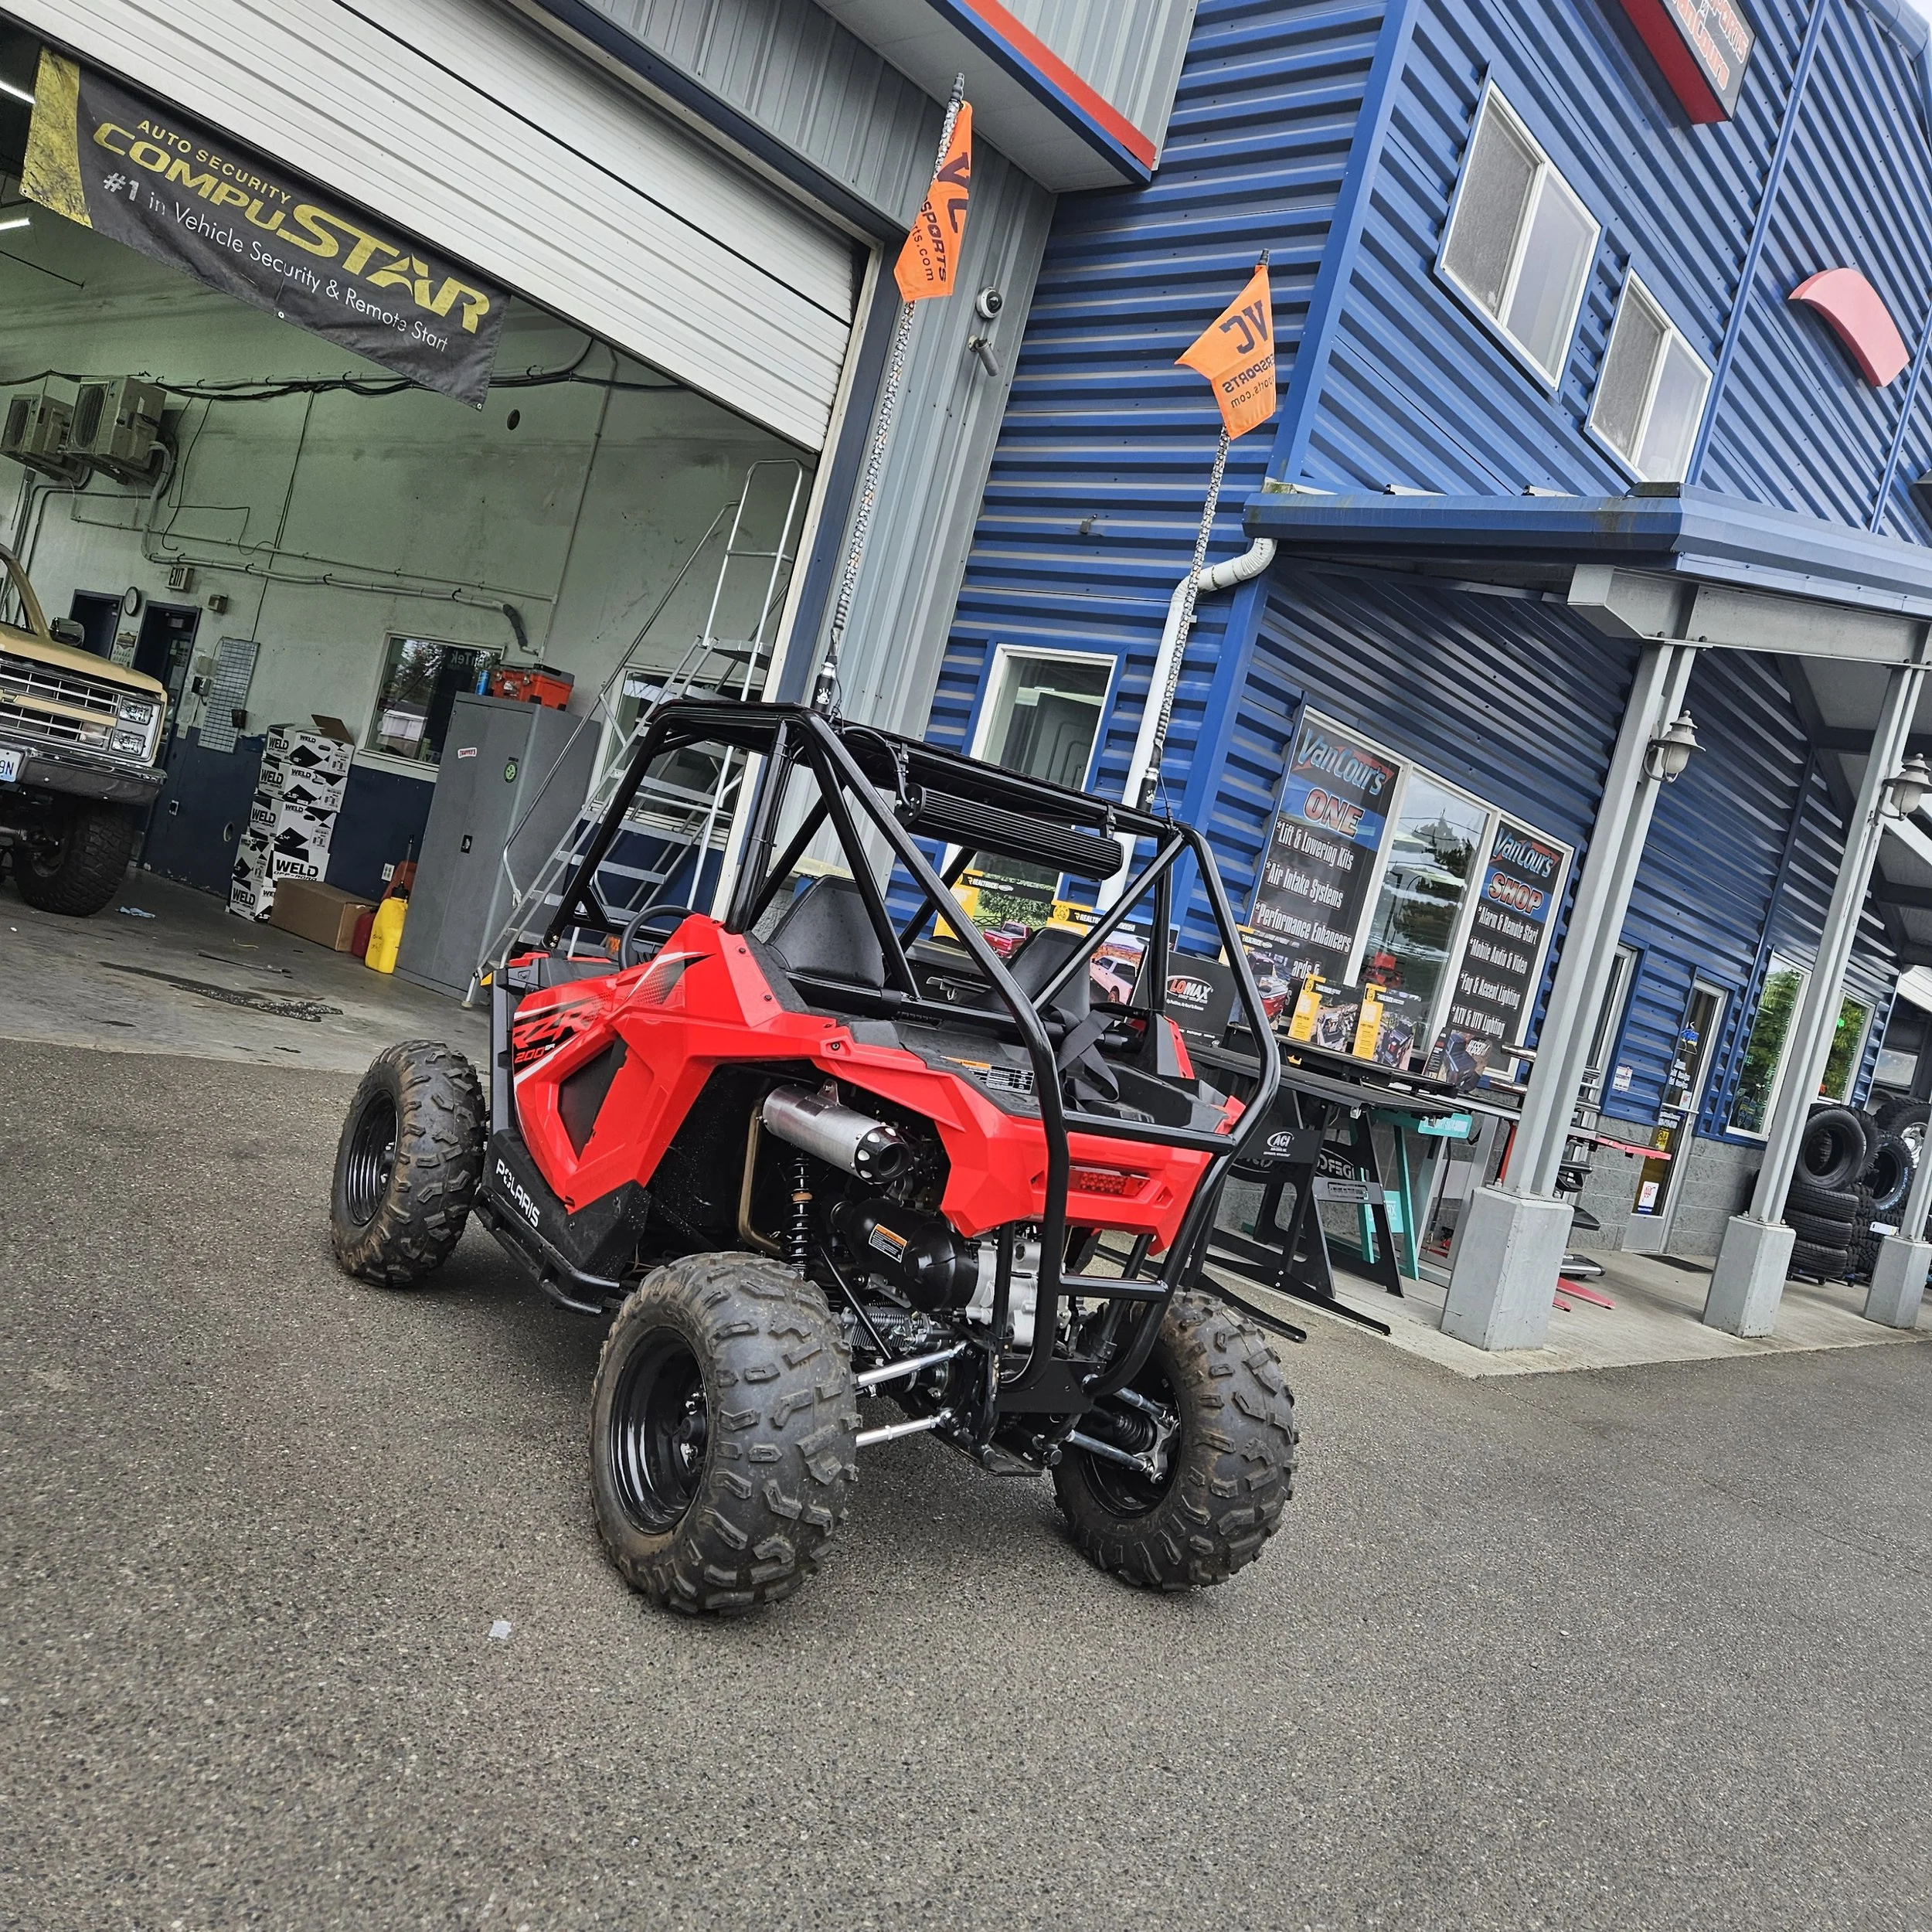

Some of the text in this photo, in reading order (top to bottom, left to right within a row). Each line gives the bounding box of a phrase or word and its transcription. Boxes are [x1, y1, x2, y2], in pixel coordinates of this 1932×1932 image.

[137, 120, 292, 205] AUTO SECURITY
[103, 172, 449, 352] #1 in Vehicle Security & Remote Start
[268, 736, 290, 750] WELD
[300, 734, 316, 743] WELD
[260, 768, 284, 785] WELD
[291, 768, 311, 779] WELD
[1298, 728, 1386, 796] VanCour's
[251, 808, 277, 825] WELD
[284, 804, 304, 813] WELD
[1304, 787, 1366, 840] ONE
[1294, 828, 1302, 851] &
[1301, 832, 1338, 867] Lowering
[1337, 846, 1354, 871] Kits
[1492, 828, 1555, 878] VanCour's
[276, 859, 319, 878] WELD
[232, 888, 256, 906] WELD
[1283, 868, 1310, 896] Intake
[1309, 879, 1344, 909] Systems
[1488, 872, 1544, 915] SHOP
[1311, 923, 1352, 953] Enhancers
[1497, 913, 1503, 930] &
[1502, 916, 1524, 940] Remote
[1522, 923, 1539, 945] Start
[1490, 946, 1507, 968] Audio
[1506, 952, 1513, 968] &
[1512, 954, 1528, 975] Video
[1169, 978, 1211, 1002] LOMAX
[1473, 977, 1480, 994] &
[1478, 978, 1500, 1002] Accent
[1498, 985, 1521, 1010] Lighting
[1464, 1011, 1471, 1026] &
[1470, 1012, 1484, 1030] UTV
[1482, 1015, 1505, 1039] Lighting
[514, 1047, 545, 1064] 200
[1273, 1134, 1291, 1148] ACI
[495, 1158, 540, 1227] POLARIS
